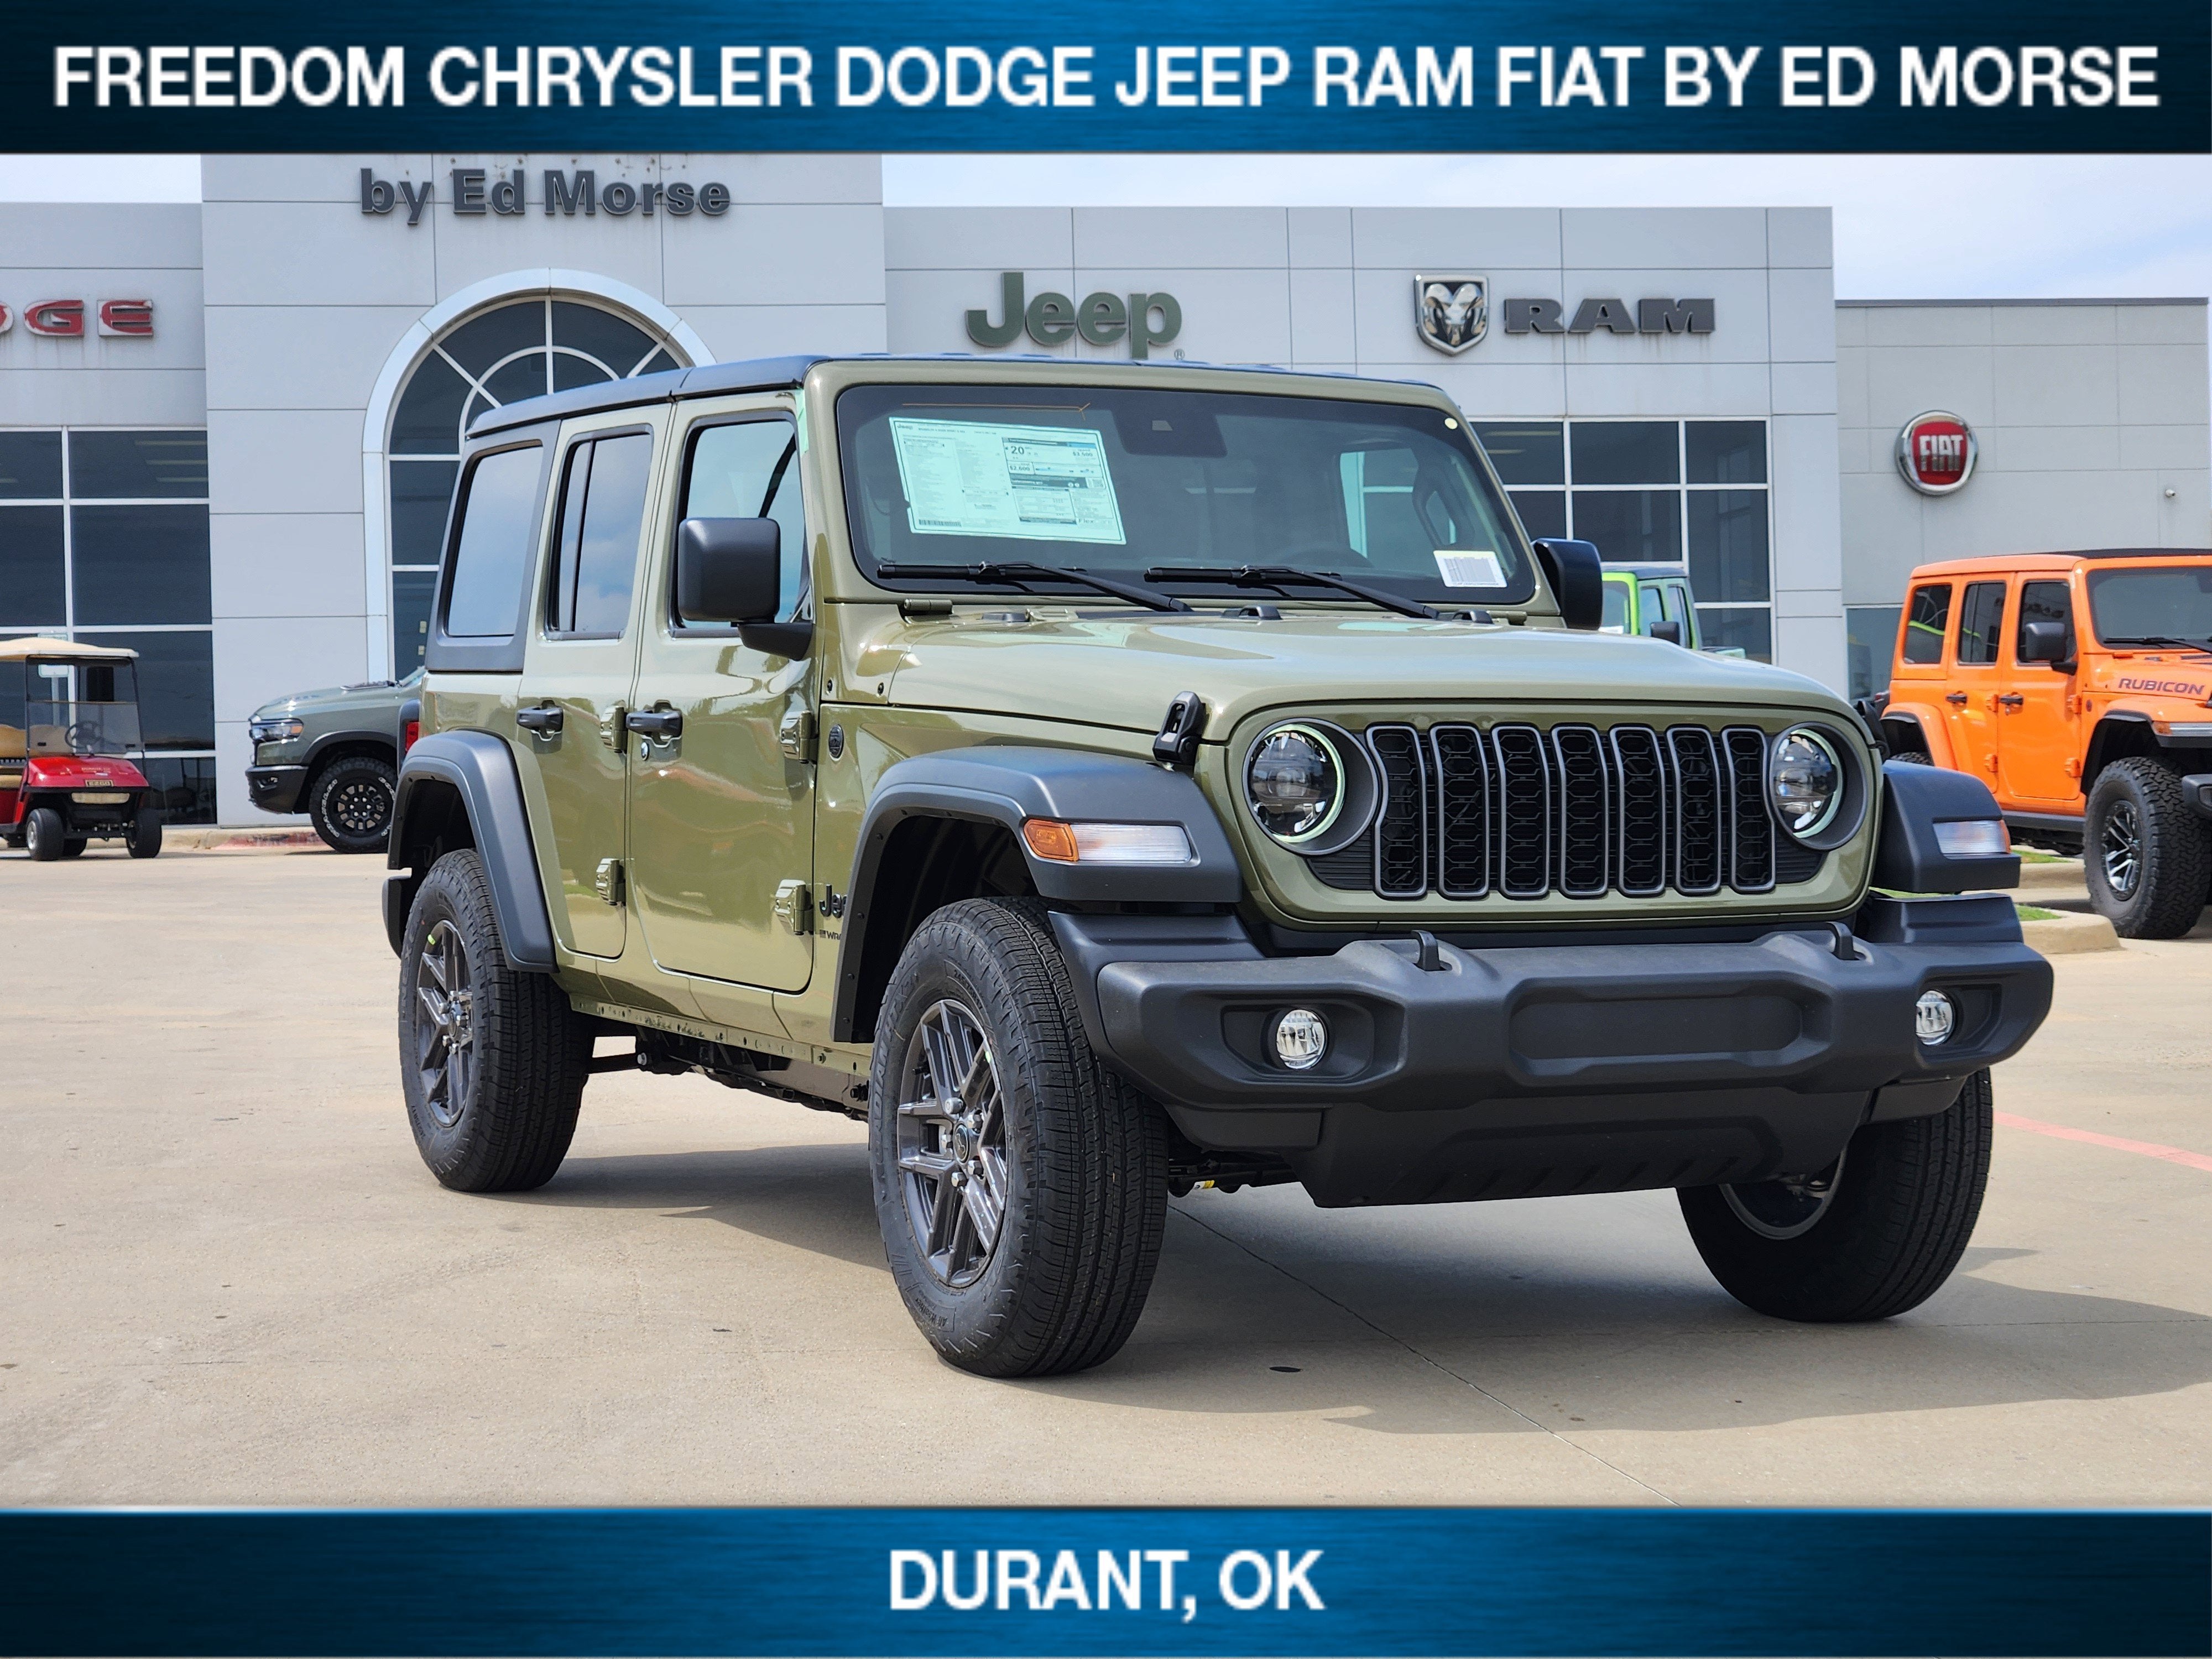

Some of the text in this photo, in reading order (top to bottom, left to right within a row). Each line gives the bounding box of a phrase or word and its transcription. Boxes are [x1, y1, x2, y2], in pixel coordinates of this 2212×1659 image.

[360, 168, 731, 224] by Ed Morse
[0, 300, 153, 336] GE
[966, 272, 1182, 359] Jeep
[1504, 298, 1715, 333] RAM
[1010, 446, 1025, 455] 20
[1919, 434, 1964, 472] FIAT
[2118, 678, 2205, 695] RUBICON
